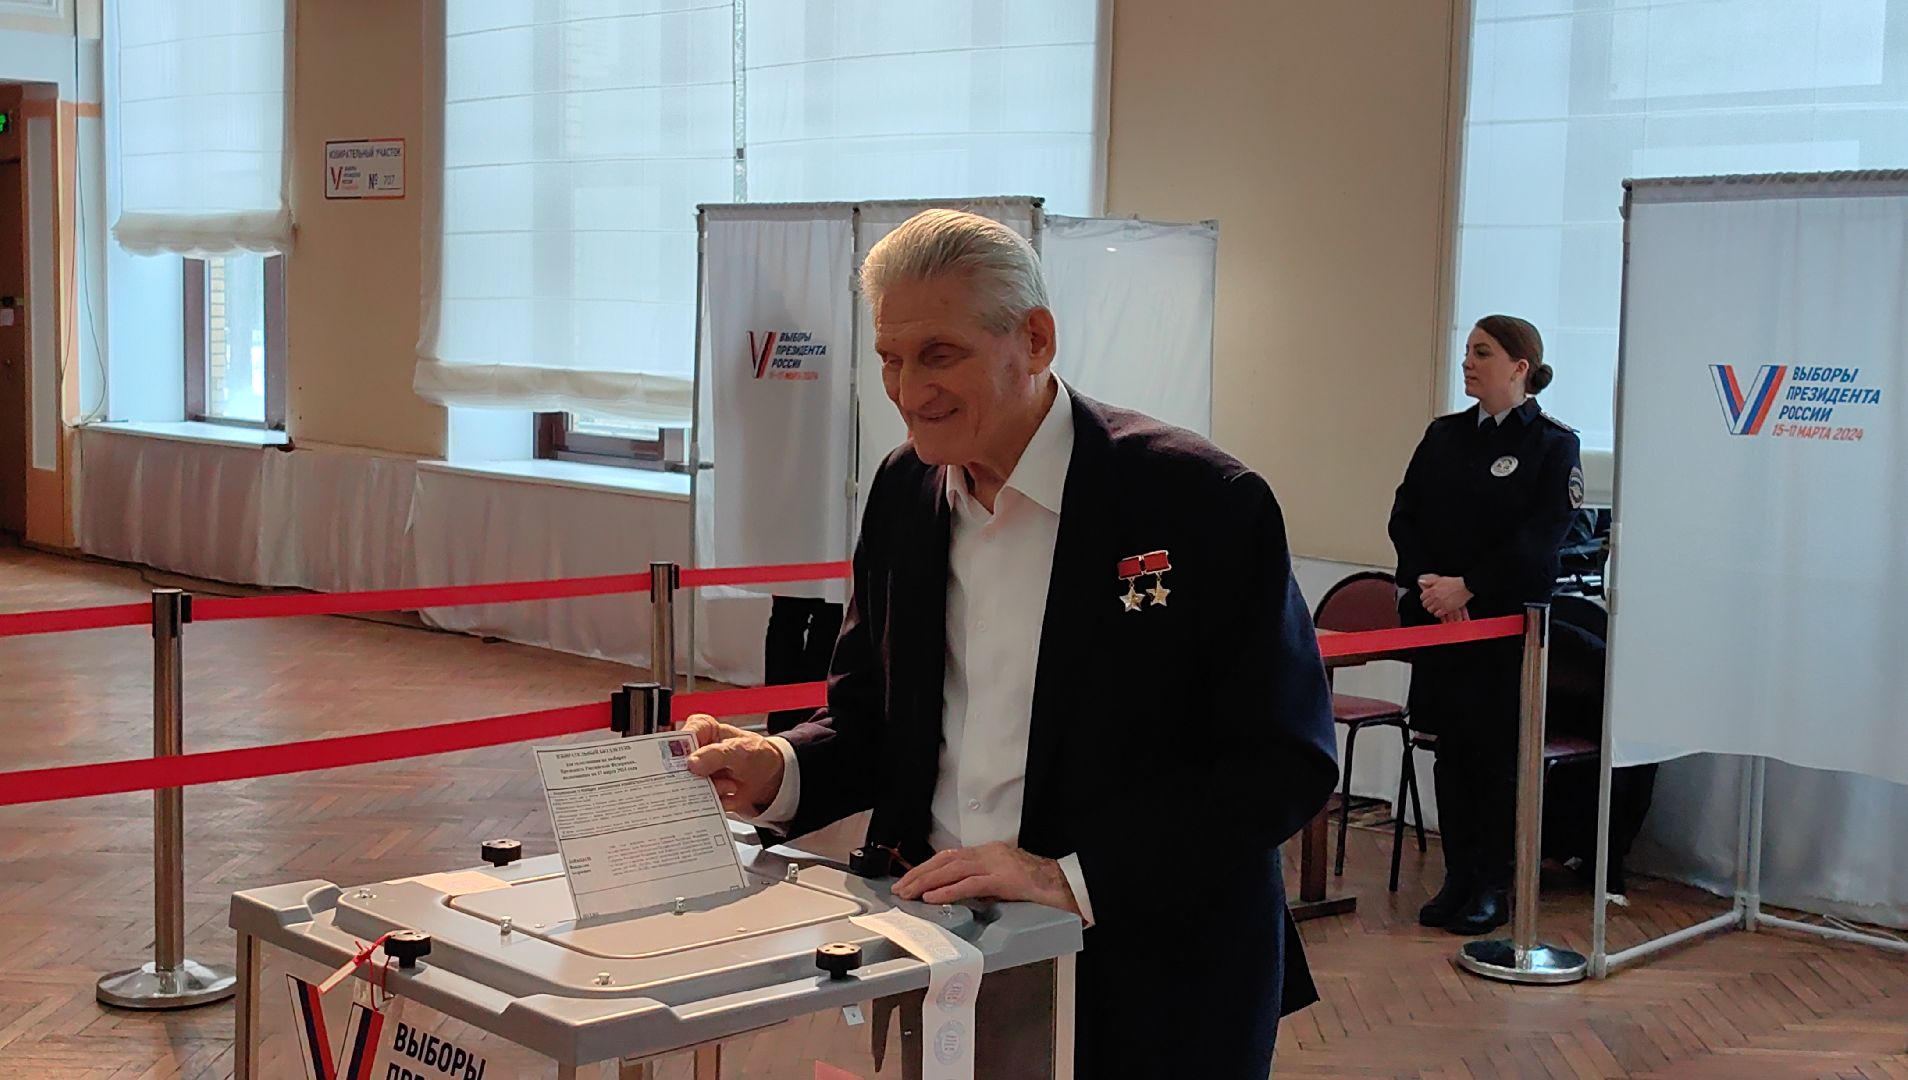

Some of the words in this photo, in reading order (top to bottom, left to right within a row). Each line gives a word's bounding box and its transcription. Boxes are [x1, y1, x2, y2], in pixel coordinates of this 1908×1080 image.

[779, 332, 813, 342] ВЫБОРЫ
[775, 345, 827, 355] ПРЕЗИДЕНТА
[771, 359, 802, 368] РОССИИ
[1792, 366, 1859, 383] ВЫБОРЫ
[1786, 386, 1881, 405] ПРЕЗИДЕНТА
[1778, 405, 1833, 422] РОССИИ
[1797, 426, 1832, 439] МАРТА
[1832, 428, 1864, 440] 2024
[393, 1022, 487, 1080] ВЫБОРЫ
